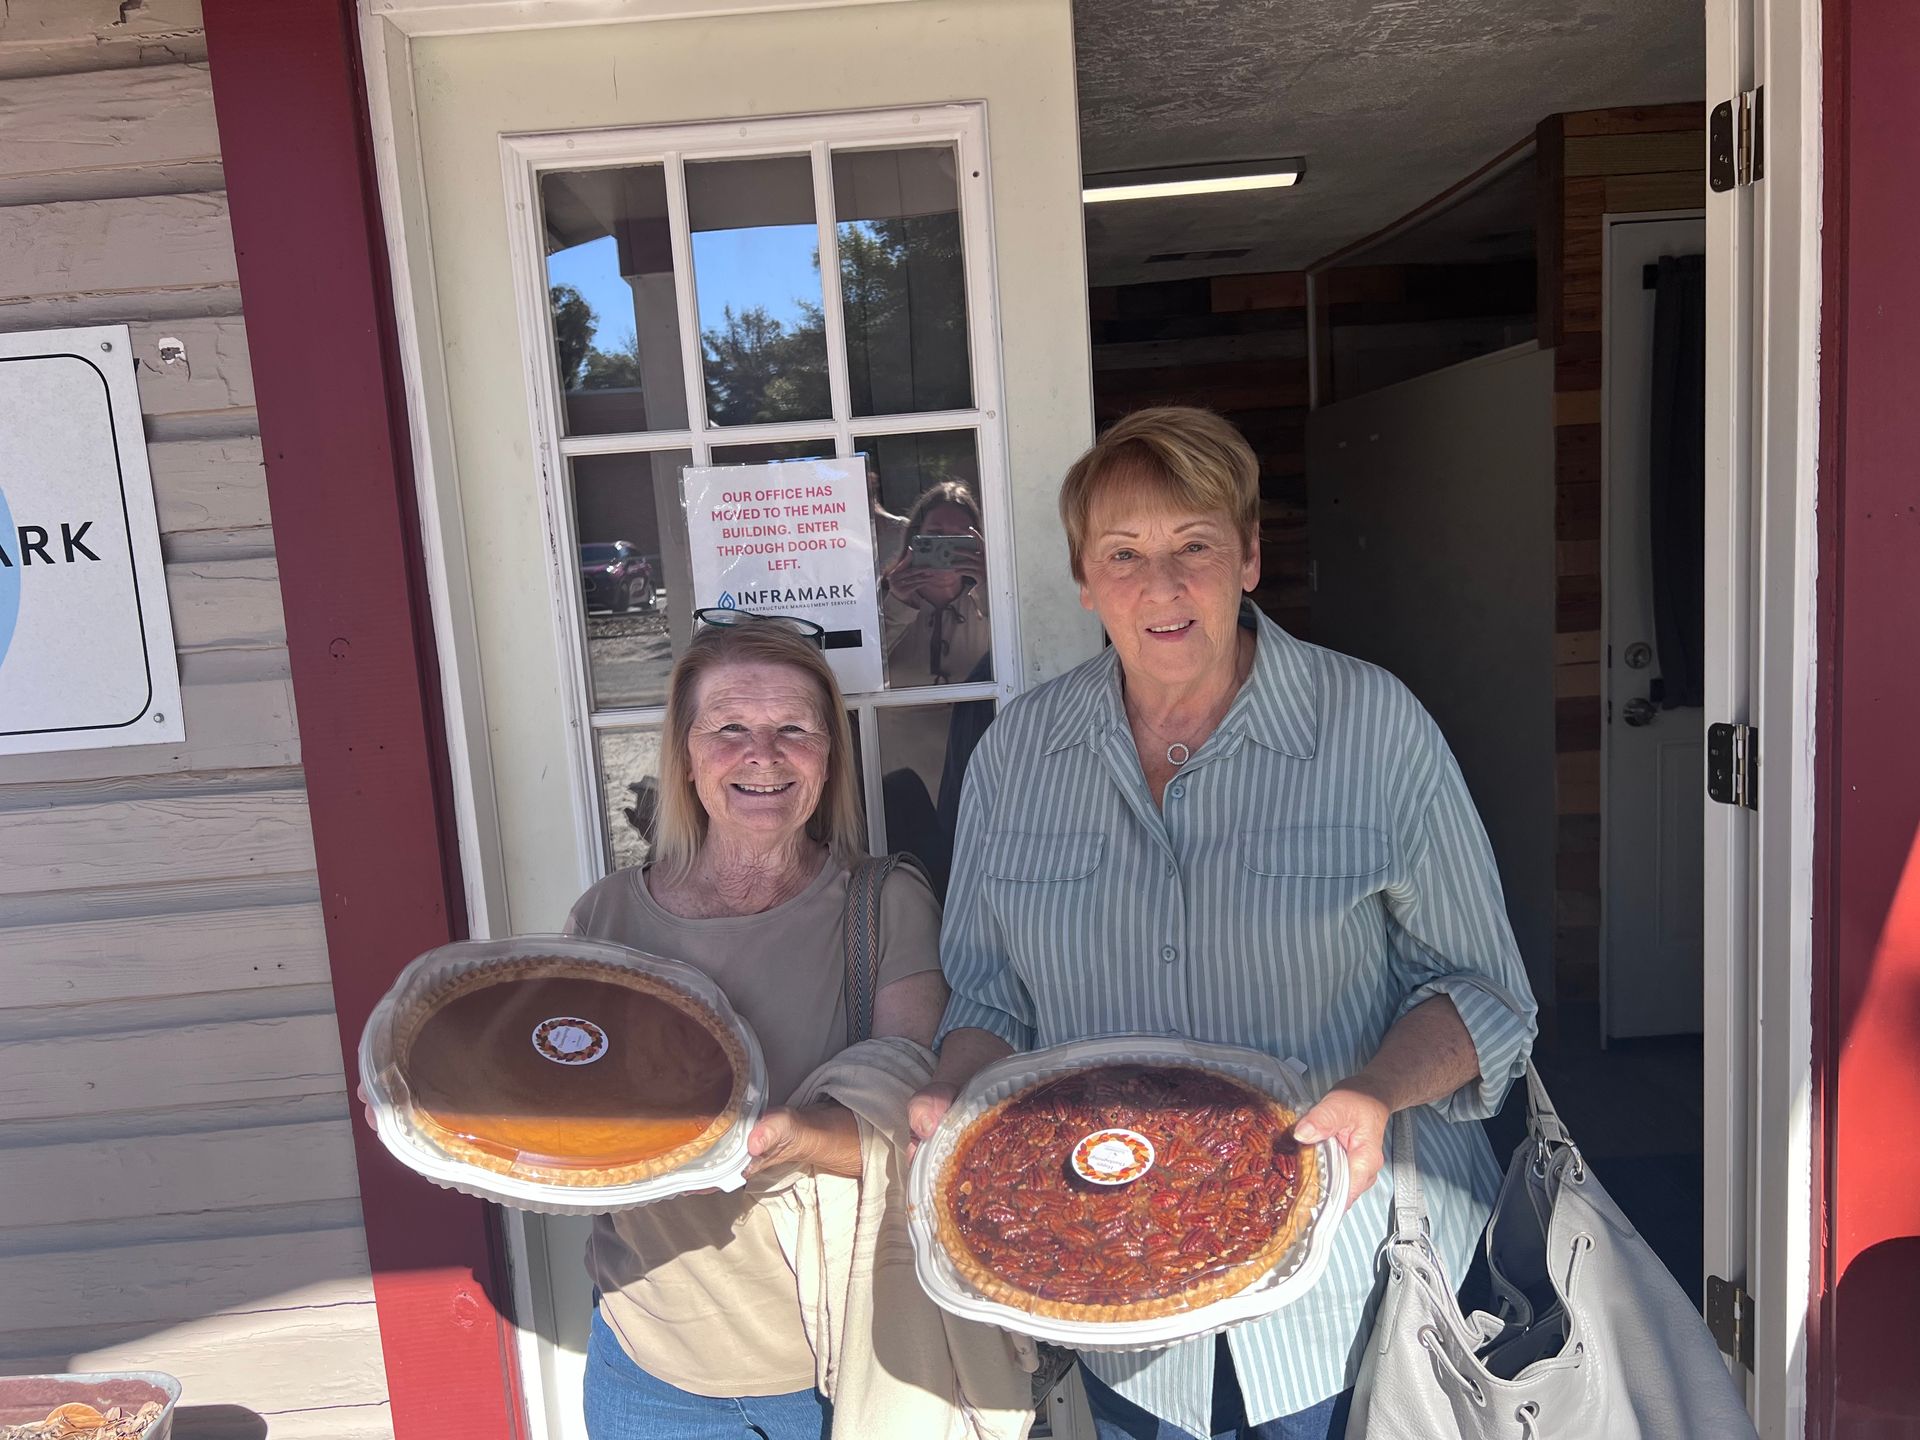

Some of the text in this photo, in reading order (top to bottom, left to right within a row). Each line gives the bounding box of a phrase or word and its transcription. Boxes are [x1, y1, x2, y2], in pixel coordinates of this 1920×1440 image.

[722, 485, 833, 503] OUR OFFICE HAS
[711, 502, 846, 522] MOVED TO THE MAIN
[722, 521, 839, 539] BUILDING. ENTER
[717, 537, 847, 557] THROUGH DOOR TO
[768, 559, 801, 571] LEFT.
[738, 584, 855, 605] INFRAMARK
[830, 599, 857, 607] SERVICES
